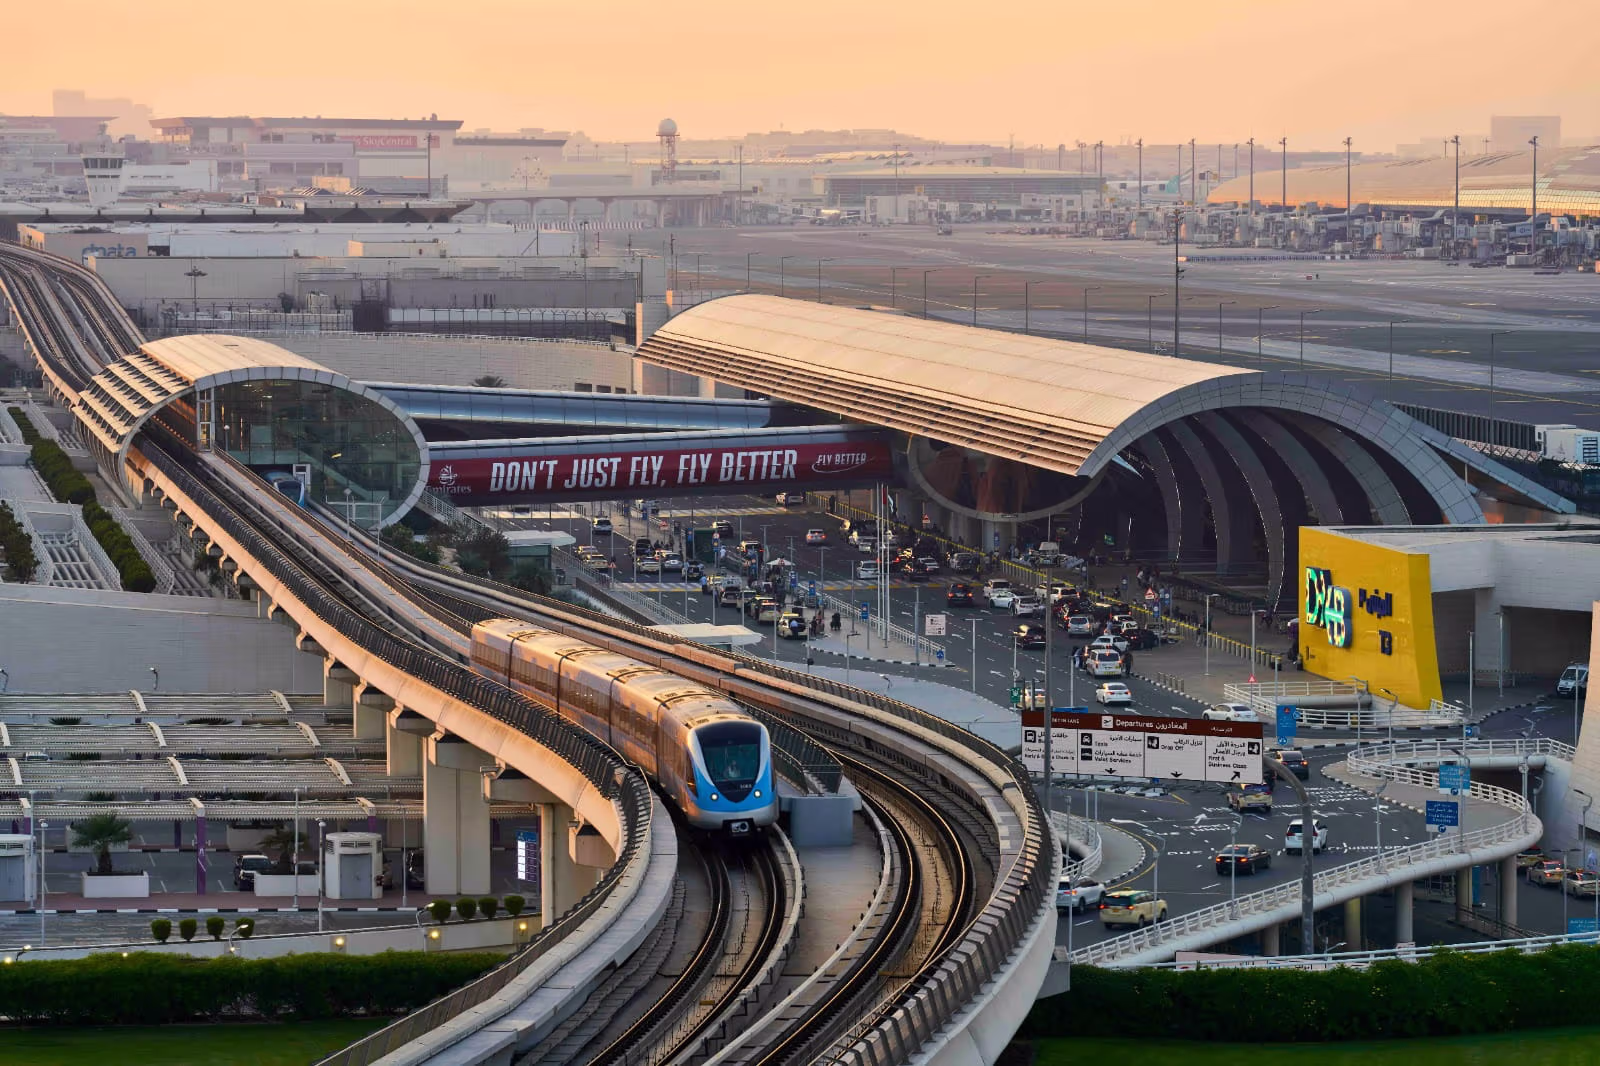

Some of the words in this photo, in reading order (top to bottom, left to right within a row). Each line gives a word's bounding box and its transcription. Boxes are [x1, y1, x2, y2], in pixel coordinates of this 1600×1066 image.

[817, 453, 832, 465] FLY
[834, 452, 867, 465] BETTER
[489, 459, 558, 492] DON'T
[564, 456, 622, 489] JUST
[628, 455, 667, 488] FLY,
[677, 452, 713, 484] FLY
[719, 449, 798, 482] BETTER
[1379, 629, 1393, 656] T3
[1116, 719, 1153, 728] Departures
[1156, 721, 1188, 730] المغادرون
